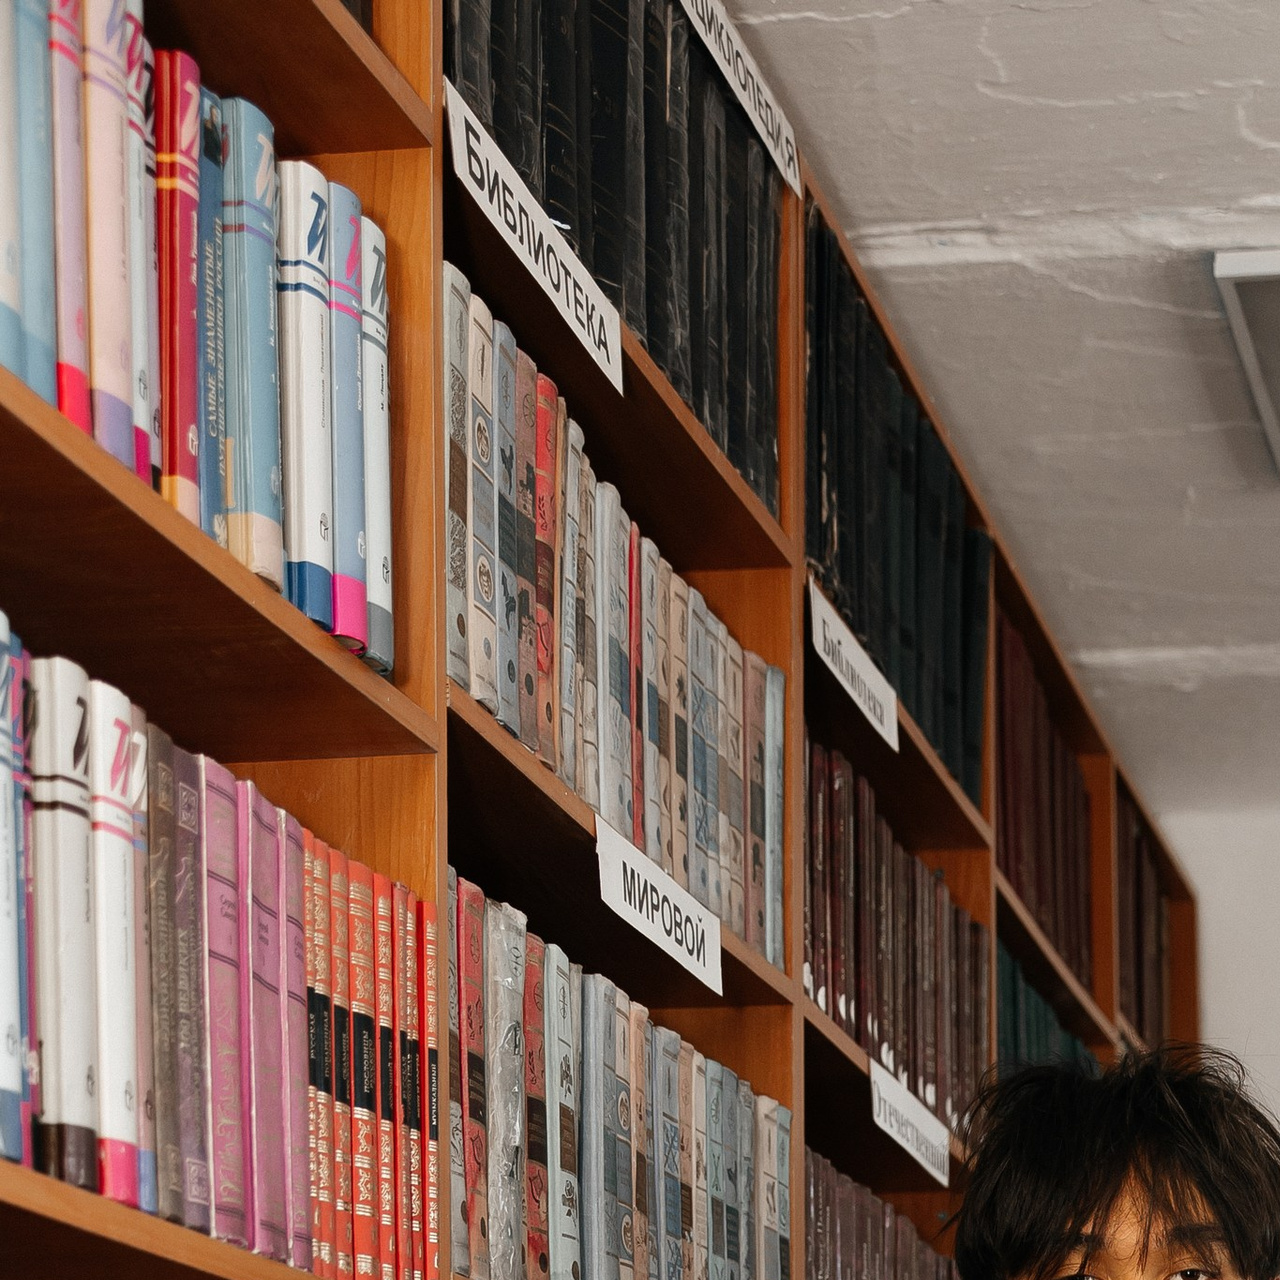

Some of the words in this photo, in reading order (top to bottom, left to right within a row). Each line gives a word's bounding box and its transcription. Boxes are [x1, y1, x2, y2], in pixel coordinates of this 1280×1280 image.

[691, 0, 797, 180] ЦИКЛОПЕДИЯ
[204, 239, 216, 367] ЗНАМЕНИТЫЕ
[464, 115, 611, 366] БИБЛИОТЕКА
[208, 373, 218, 438] САМЫЕ
[622, 860, 706, 968] МИРОВОЙ
